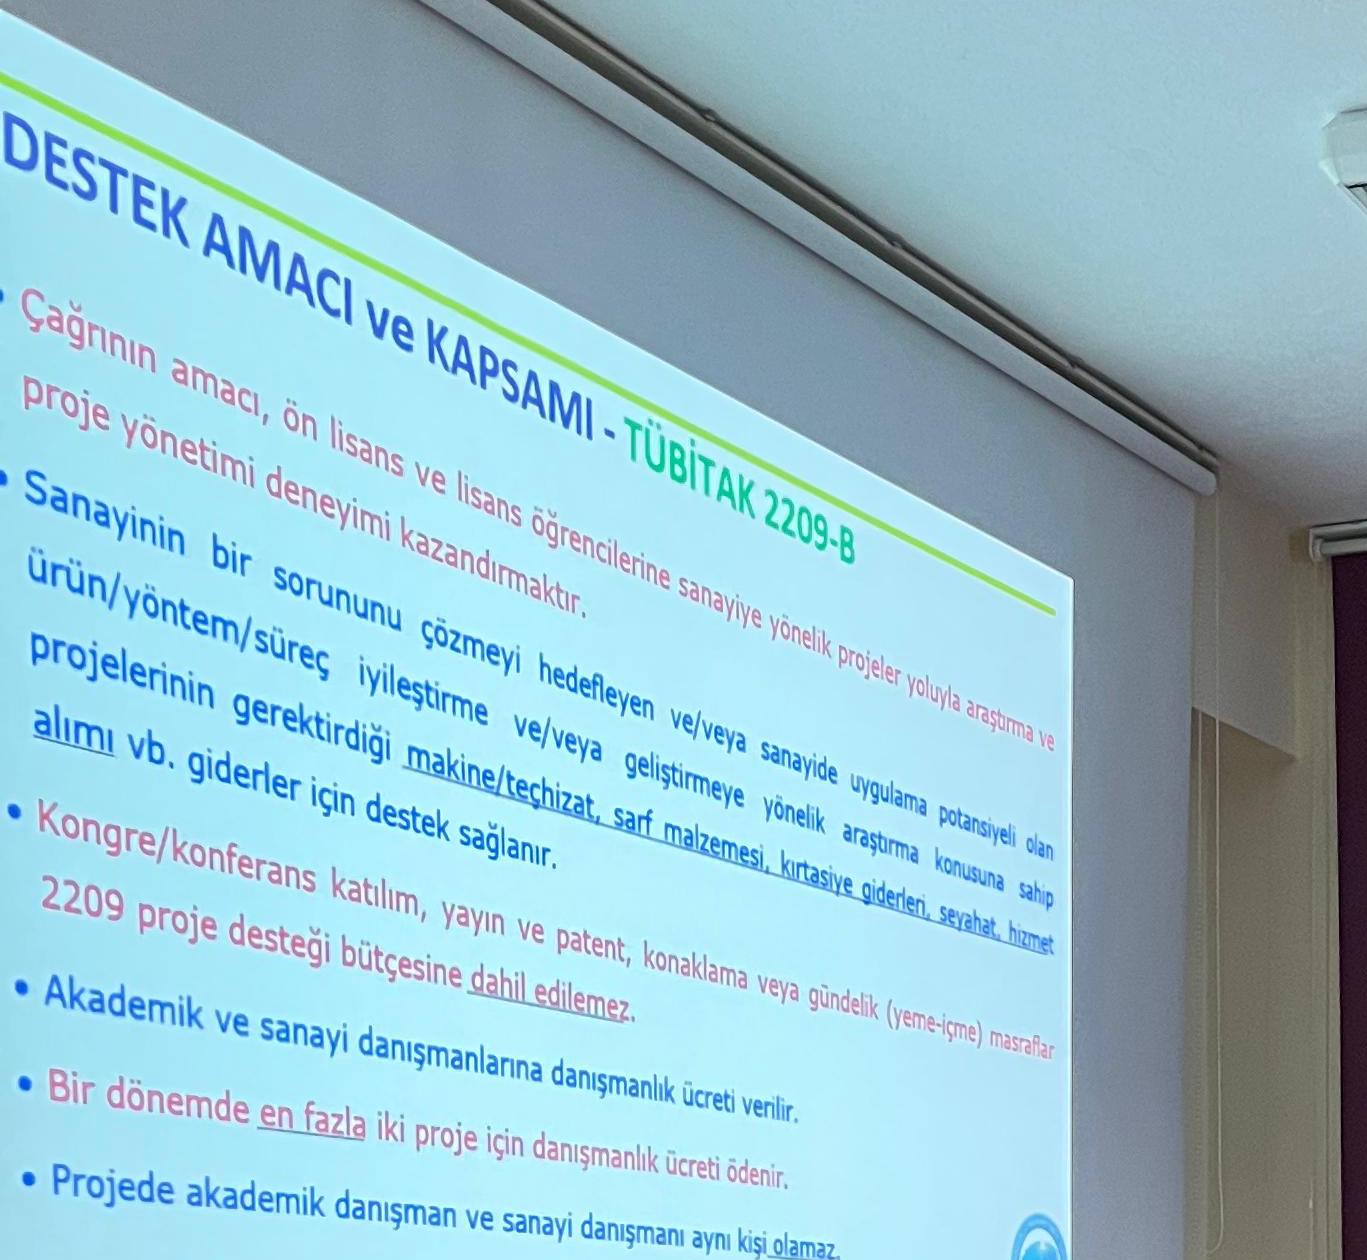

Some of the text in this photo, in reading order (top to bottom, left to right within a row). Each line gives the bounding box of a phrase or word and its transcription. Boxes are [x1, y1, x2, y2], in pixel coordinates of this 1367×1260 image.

[2, 111, 189, 248] DESTEK
[203, 212, 353, 325] AMACI
[367, 299, 414, 352] ve
[427, 318, 593, 441] KAPSAMI
[623, 416, 756, 520] TÜBİTAK
[764, 489, 855, 565] 2209-B
[21, 288, 1055, 751] Çağrının amacı, ön lisans ve lisans öğrencilerine sanayiye yönelik projeler yoluyla araştırma ve
[23, 374, 587, 618] proje yönetimi deneyimi kazandırmaktır.
[24, 470, 1054, 861] Sanayinin bir sorununu çözmeyi hedefleyen ve/veya sanayide uygulama potansiyeli olan
[28, 545, 1054, 911] ürün/yöntem/süreç iyileştirme ve/veya geliştirmeye yönelik araştırma konusuna sahip
[33, 704, 557, 870] alımı vb. giderler için destek sağlanır.
[30, 630, 1055, 955] projelerinin gerektirdiği makine/teçhizat, sarf malzemesi, kırtasiye giderleri, seyahat, hizmet
[37, 798, 317, 893] Kongre/konferans
[331, 866, 427, 923] katılım,
[442, 899, 505, 937] yayın
[518, 918, 545, 944] ve
[556, 924, 632, 968] patent,
[643, 940, 748, 990] konaklama
[757, 971, 799, 1003] veya
[808, 984, 879, 1020] gündelik
[886, 998, 982, 1050] (yeme-içme)
[40, 874, 636, 1024] 2209 proje desteği bütçesine dahil edilemez.
[44, 974, 798, 1124] Akademik ve sanayi danışmanlarına danışmanlık ücreti verilir.
[48, 1069, 788, 1190] Bir dönemde en fazla iki proje için danışmanlık ücreti ödenir.
[52, 1163, 174, 1208] Projede
[187, 1176, 325, 1217] akademik
[336, 1190, 456, 1230] danışman
[466, 1206, 494, 1230] ve
[502, 1210, 573, 1238] sanayi
[581, 1215, 685, 1249] danışmanı
[692, 1227, 731, 1253] aynı
[738, 1232, 768, 1258] kişi
